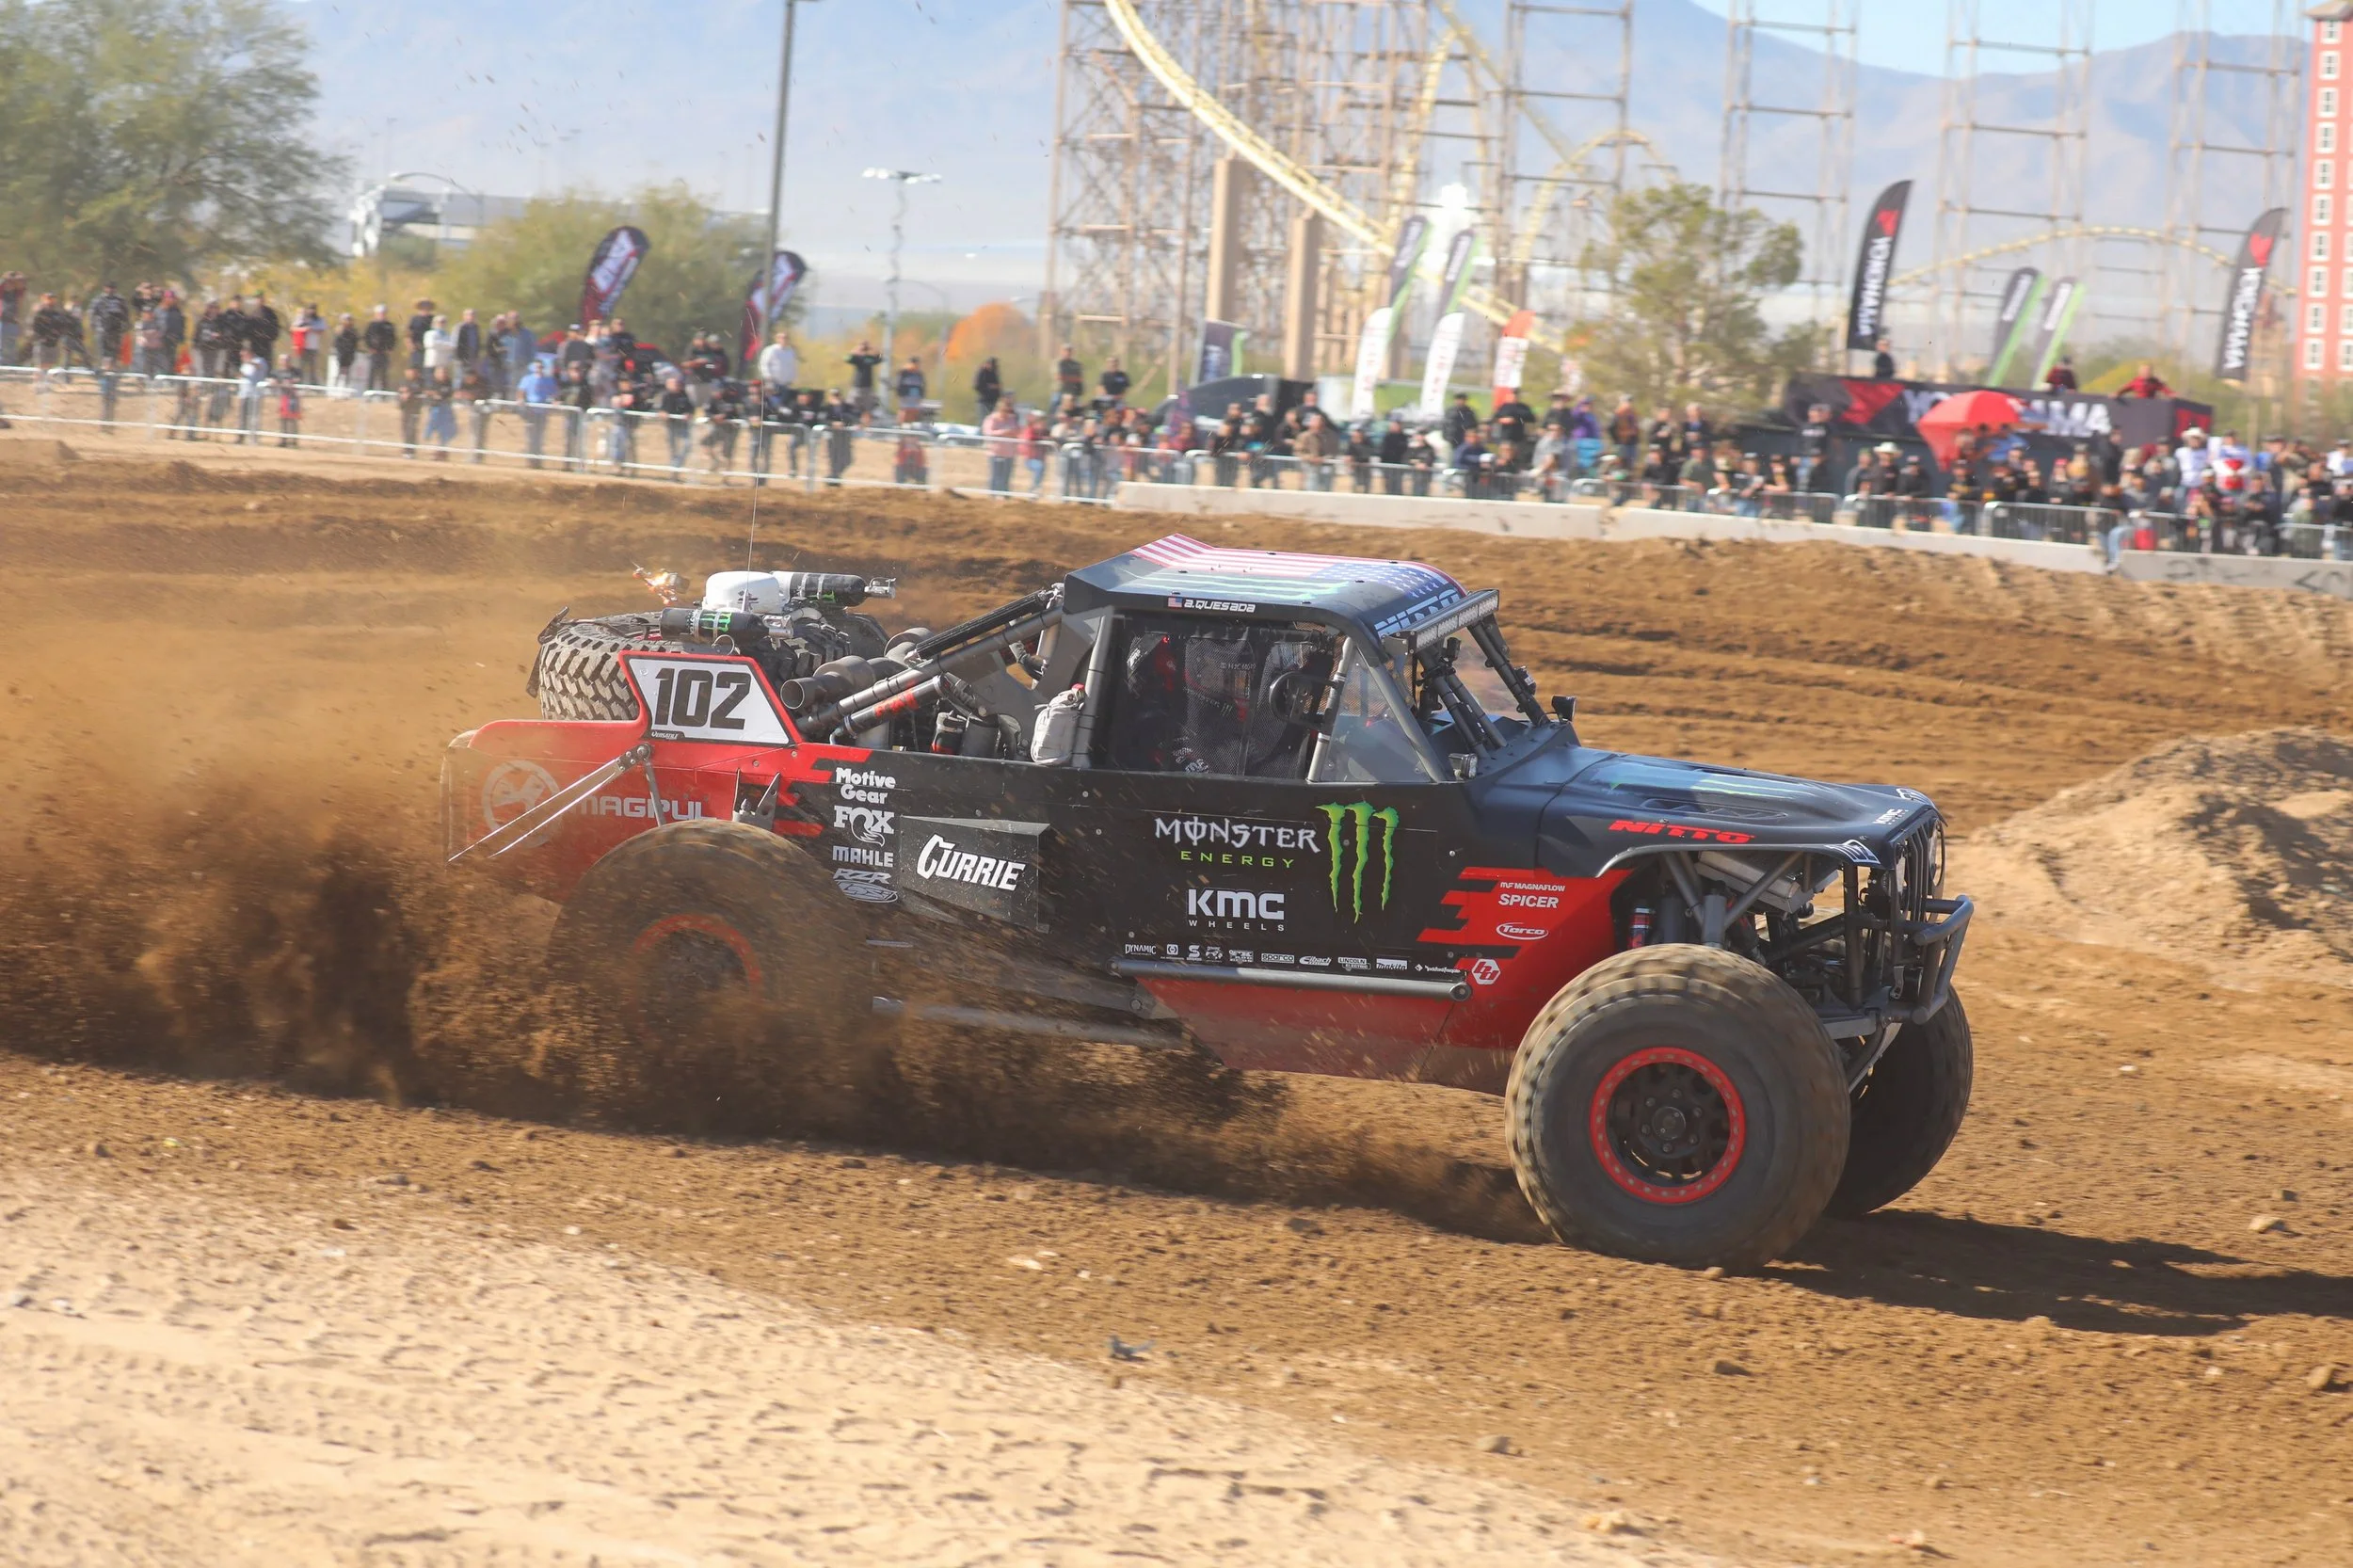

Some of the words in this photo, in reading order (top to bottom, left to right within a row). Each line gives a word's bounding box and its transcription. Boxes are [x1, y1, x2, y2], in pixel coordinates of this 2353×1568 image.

[652, 667, 752, 729] 102
[836, 767, 896, 789] Motive
[840, 784, 888, 804] Gear
[834, 805, 894, 843] FOX
[1155, 816, 1321, 854] MONSTER
[832, 846, 893, 867] MAHLE
[917, 834, 1026, 891] CURRIE
[1180, 851, 1294, 868] ENERGY
[833, 868, 891, 884] RZR
[1513, 882, 1565, 892] MAGNAFLOW
[1498, 893, 1560, 908] SPICER
[1189, 920, 1285, 931] WHEELS
[1125, 944, 1157, 954] DYNAMIC
